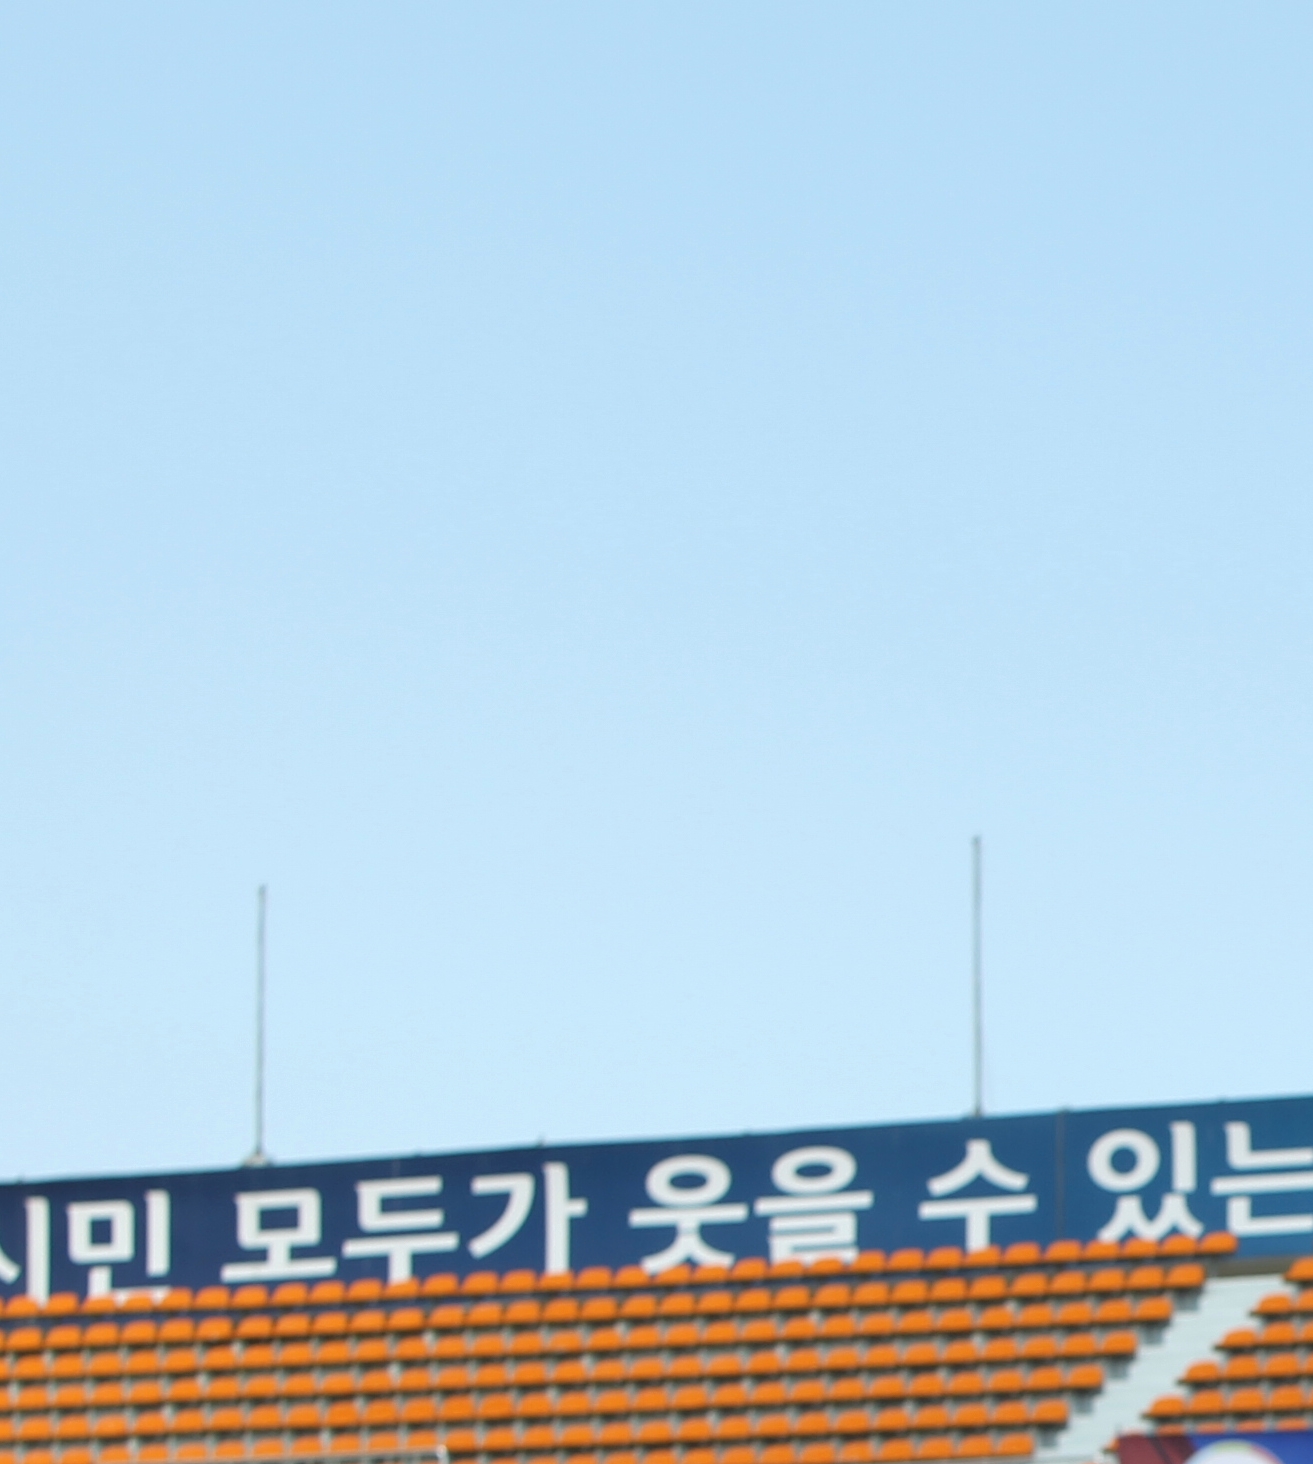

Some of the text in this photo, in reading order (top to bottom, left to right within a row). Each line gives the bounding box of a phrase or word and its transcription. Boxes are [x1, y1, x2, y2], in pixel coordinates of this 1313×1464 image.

[221, 1160, 587, 1284] 모두가
[628, 1146, 874, 1274] 웃을
[918, 1139, 1036, 1255] 수
